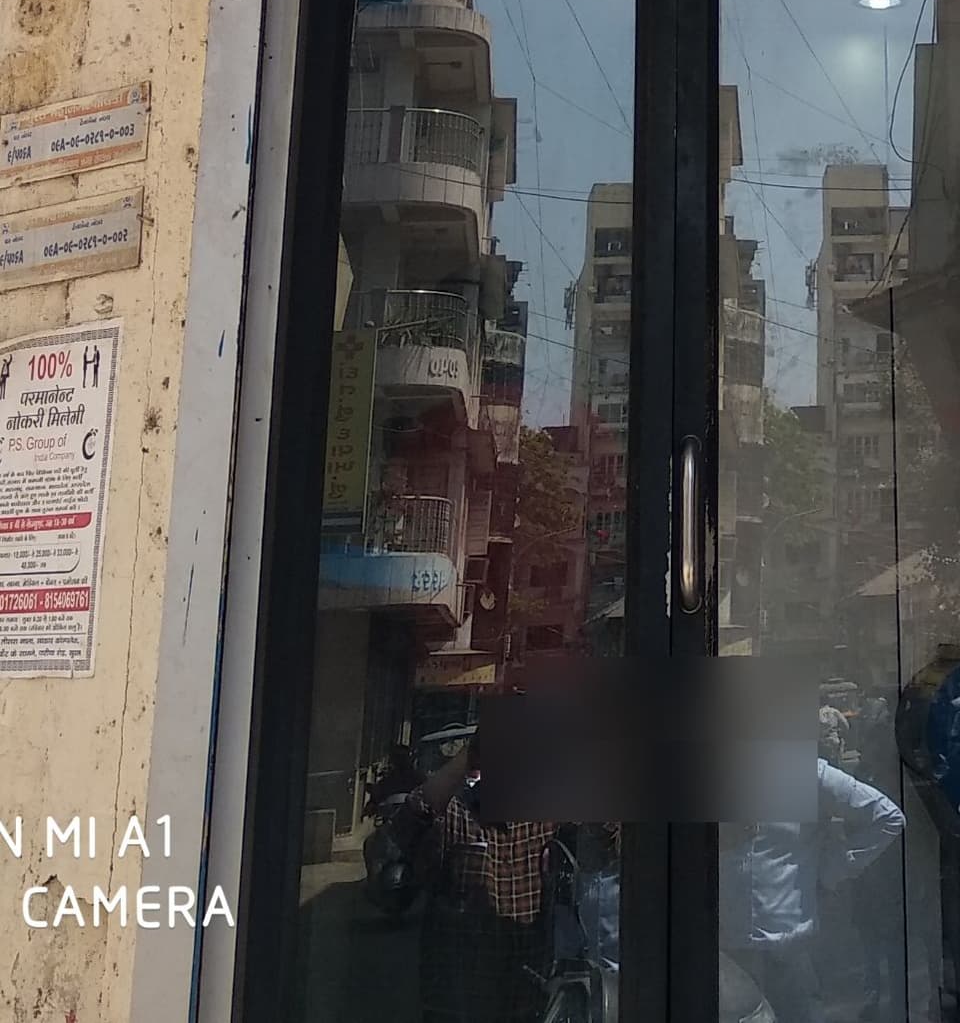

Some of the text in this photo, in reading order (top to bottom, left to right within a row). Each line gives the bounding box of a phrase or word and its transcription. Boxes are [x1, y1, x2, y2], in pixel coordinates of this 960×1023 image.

[28, 349, 73, 381] 100%
[26, 435, 56, 451] Group
[57, 434, 68, 448] of
